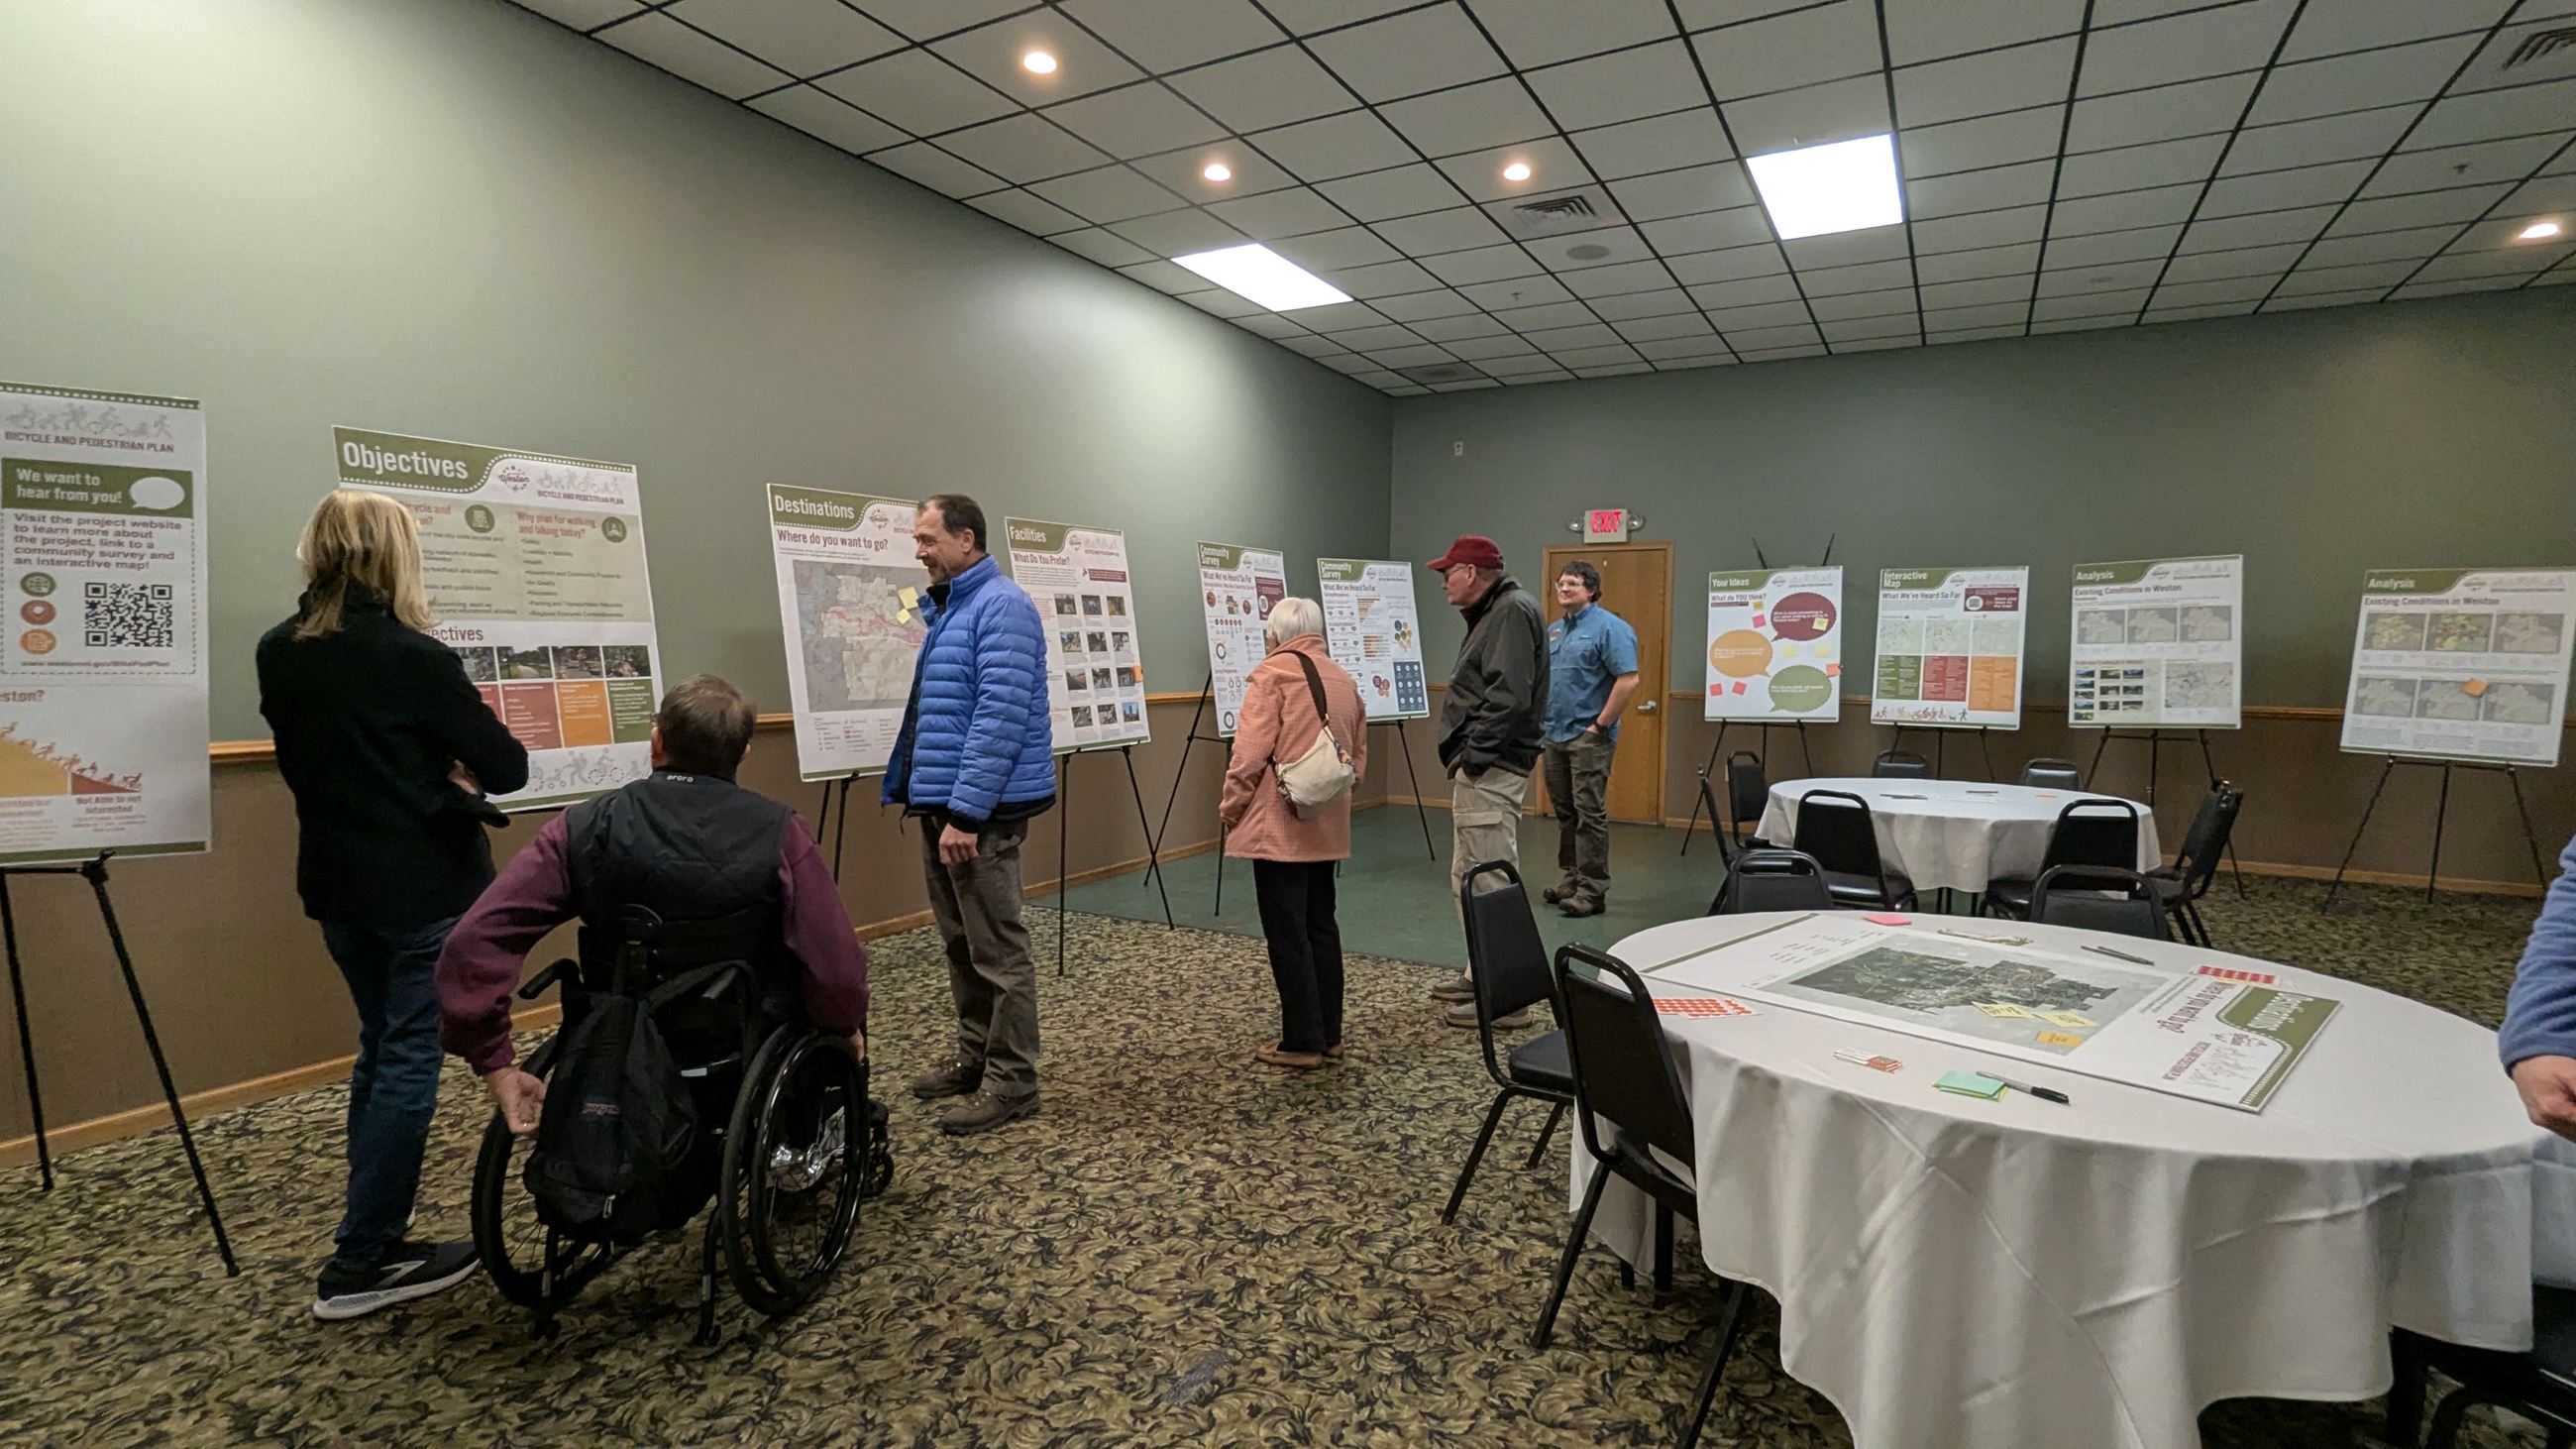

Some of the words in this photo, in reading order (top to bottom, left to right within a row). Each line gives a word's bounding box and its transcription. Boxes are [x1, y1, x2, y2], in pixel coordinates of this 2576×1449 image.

[5, 431, 52, 443] BICYCLE
[54, 436, 76, 446] AND
[79, 437, 145, 451] PEDESTRIAN
[147, 444, 174, 453] PLAN
[343, 442, 469, 479] Objectives
[16, 468, 40, 482] We
[44, 471, 81, 486] want
[85, 474, 101, 486] to
[16, 485, 52, 500] hear
[54, 489, 89, 502] from
[91, 491, 123, 505] you!
[775, 495, 855, 519] Destinations
[14, 512, 48, 523] Visit
[51, 513, 73, 525] the
[77, 516, 127, 529] project
[130, 519, 182, 530] website
[516, 510, 535, 523] Why
[1591, 510, 1622, 533] EXIT
[14, 523, 30, 533] to
[34, 524, 69, 535] learn
[73, 527, 109, 537] more
[113, 529, 153, 539] about
[1009, 525, 1046, 543] Facilities
[14, 534, 38, 545] the
[99, 538, 125, 549] link
[129, 539, 143, 549] to
[777, 529, 807, 544] Where
[808, 532, 821, 545] do
[822, 535, 838, 548] you
[839, 536, 862, 549] want
[863, 538, 873, 549] to
[874, 539, 888, 552] go?
[14, 547, 95, 559] community
[99, 549, 145, 561] survey
[150, 551, 174, 561] and
[1013, 552, 1028, 563] What
[1030, 553, 1039, 564] Do
[1039, 554, 1050, 565] You
[1050, 555, 1070, 565] Prefer?
[1200, 544, 1229, 561] Community
[37, 558, 112, 569] interactive
[1321, 561, 1351, 573] Community
[1883, 571, 1928, 581] Interactive
[2076, 571, 2114, 581] Analysis
[1883, 579, 1900, 589] Map
[2368, 579, 2415, 591] Analysis
[2075, 588, 2102, 597] Existing
[2104, 586, 2143, 595] Conditions
[2364, 597, 2400, 607] Existing
[2402, 597, 2449, 606] Conditions
[2463, 597, 2501, 606] Weston
[0, 690, 45, 702] ston?
